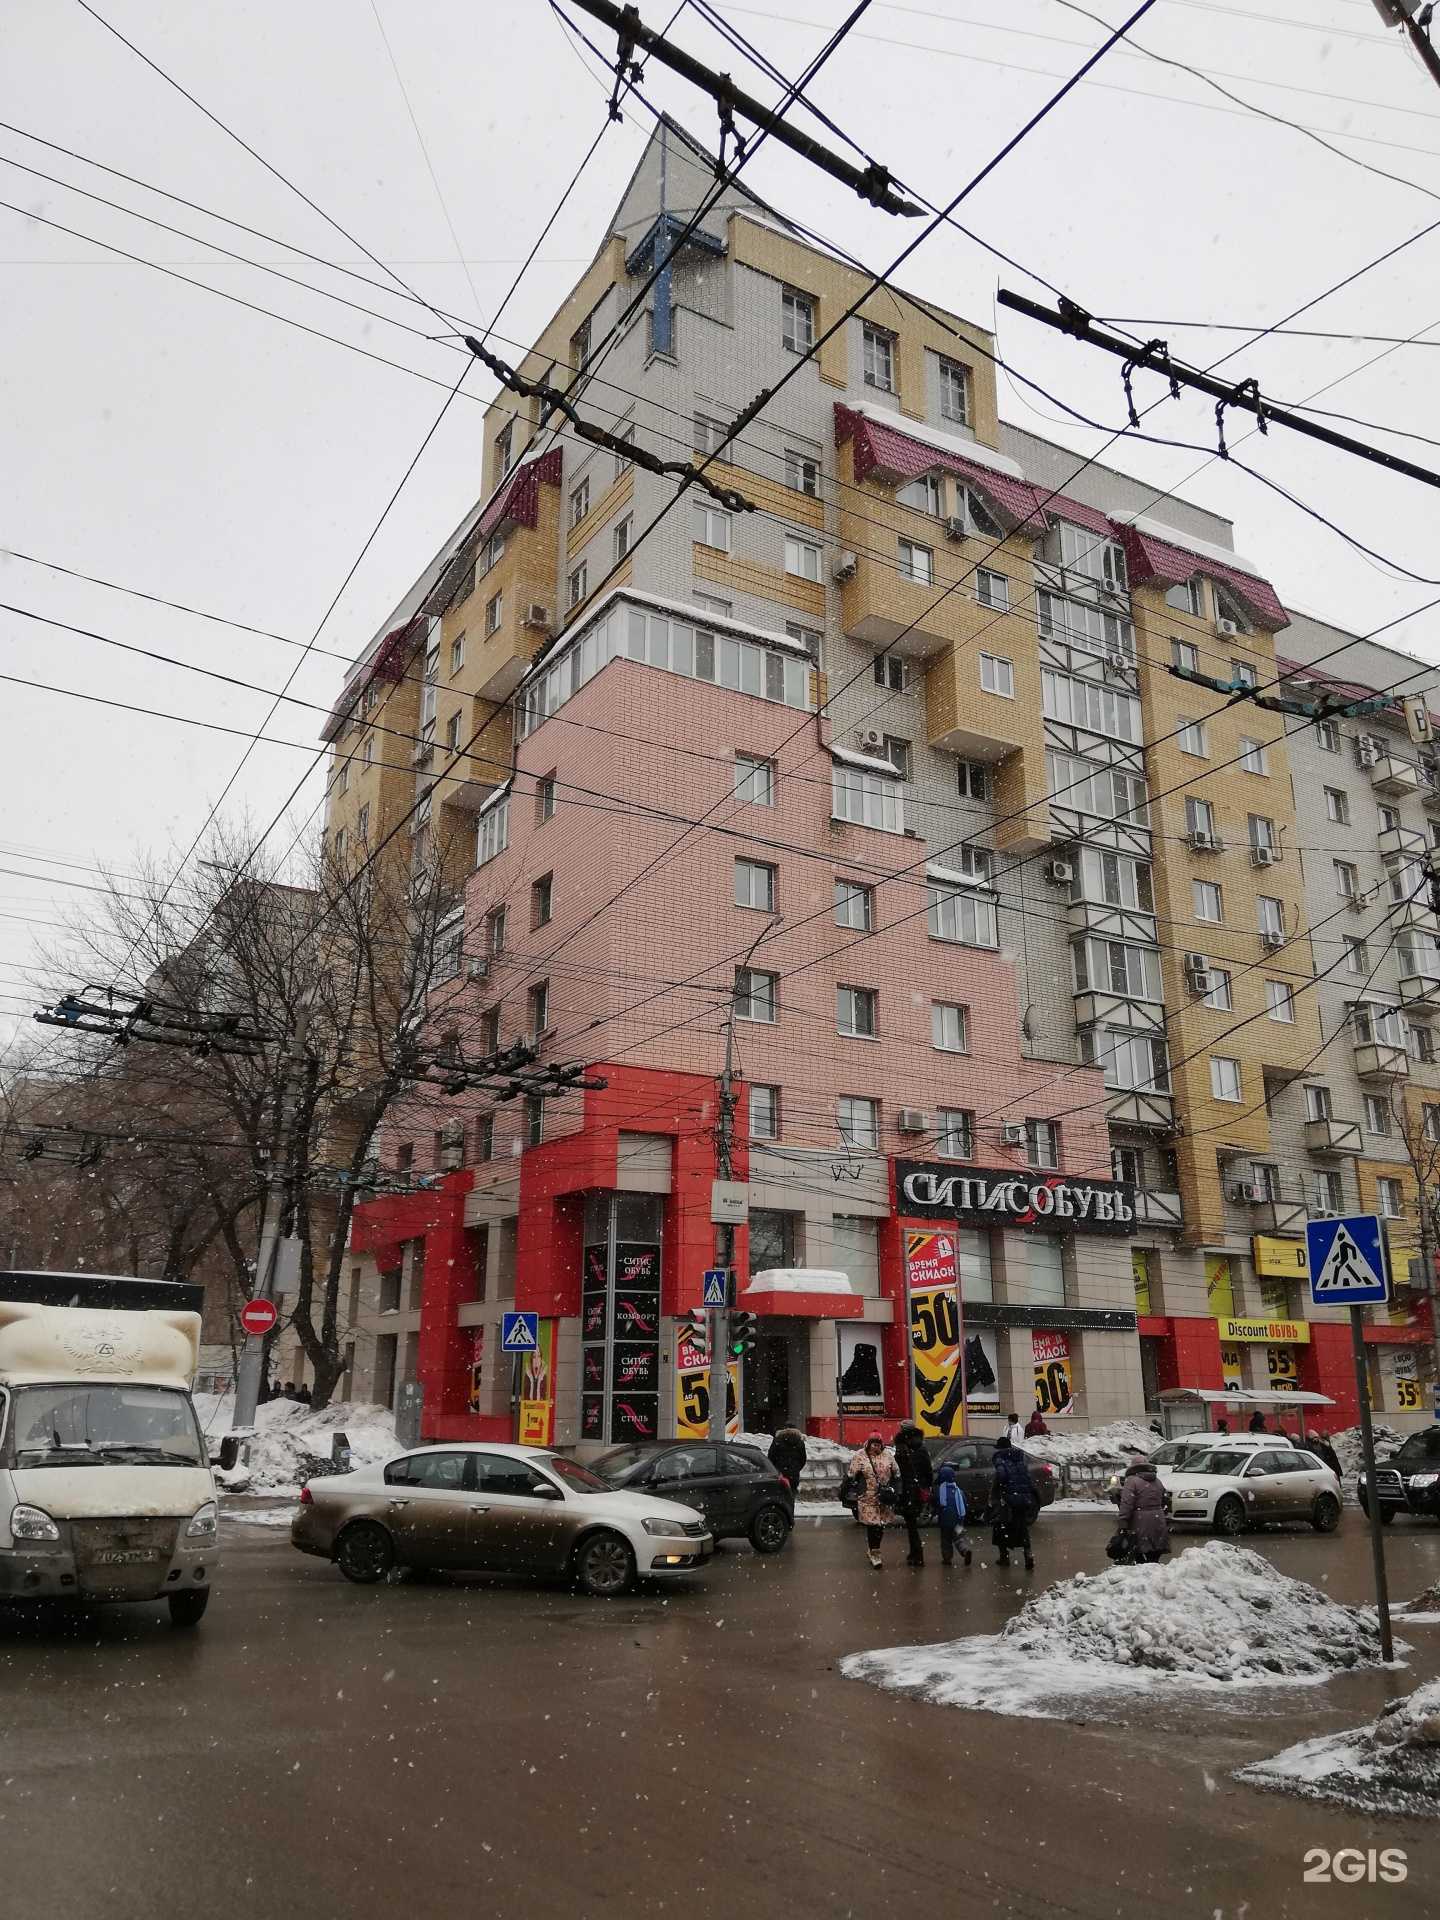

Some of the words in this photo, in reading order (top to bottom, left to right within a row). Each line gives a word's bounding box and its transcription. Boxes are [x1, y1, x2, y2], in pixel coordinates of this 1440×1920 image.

[624, 1266, 651, 1275] ОБУВЬ
[909, 1258, 938, 1271] ВРЕМЯ
[910, 1265, 955, 1282] СКИДОК
[616, 1312, 656, 1320] КОМФОРТ
[1228, 1322, 1268, 1337] Discount
[1269, 1323, 1298, 1338] ОБУВЬ
[1032, 1344, 1068, 1361] КИДОК
[621, 1357, 651, 1366] СИТИС
[622, 1367, 649, 1375] ОБУВЬ
